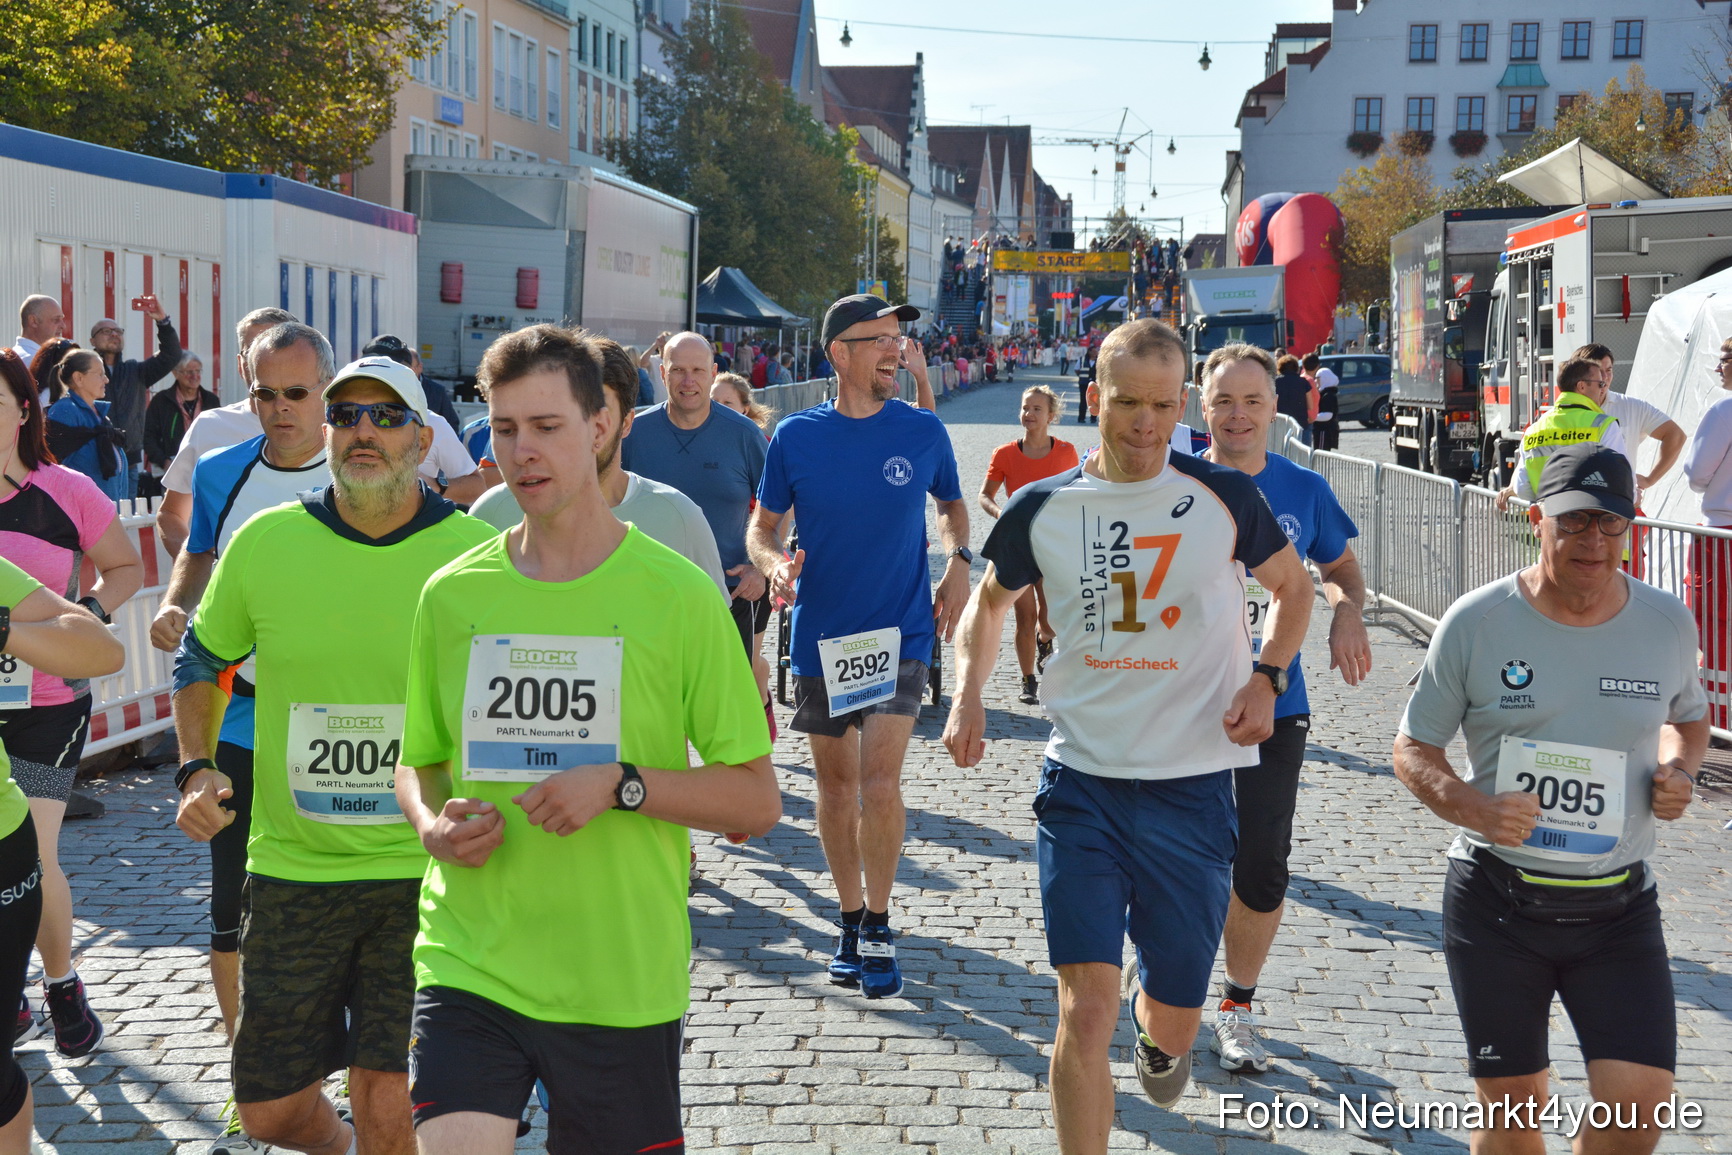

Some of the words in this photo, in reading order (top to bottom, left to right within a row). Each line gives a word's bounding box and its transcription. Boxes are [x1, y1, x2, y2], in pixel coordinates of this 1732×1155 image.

[1037, 255, 1086, 267] START
[1212, 289, 1257, 300] BOCK
[1527, 430, 1592, 446] Org.-Leiter
[1581, 479, 1609, 488] adidas
[1092, 541, 1108, 591] LAUF
[1080, 576, 1096, 632] STADT
[843, 638, 879, 652] BOCK
[510, 648, 578, 665] BOCK
[1084, 654, 1179, 671] SportScheck
[835, 650, 890, 683] 2592
[1600, 677, 1661, 696] BOCK
[486, 676, 597, 722] 2005
[846, 687, 882, 705] Christian
[1501, 694, 1535, 704] PARTL
[328, 716, 385, 729] BOCK
[496, 727, 528, 736] PARTL
[529, 728, 575, 738] Neumarkt
[308, 738, 400, 776] 2004
[524, 747, 558, 766] Tim
[1536, 751, 1592, 771] BOCK
[316, 780, 344, 788] PARTL
[345, 781, 384, 789] Neumarkt
[332, 797, 379, 812] Nader
[1547, 815, 1585, 829] Neumarkt
[1542, 831, 1567, 849] Ulli
